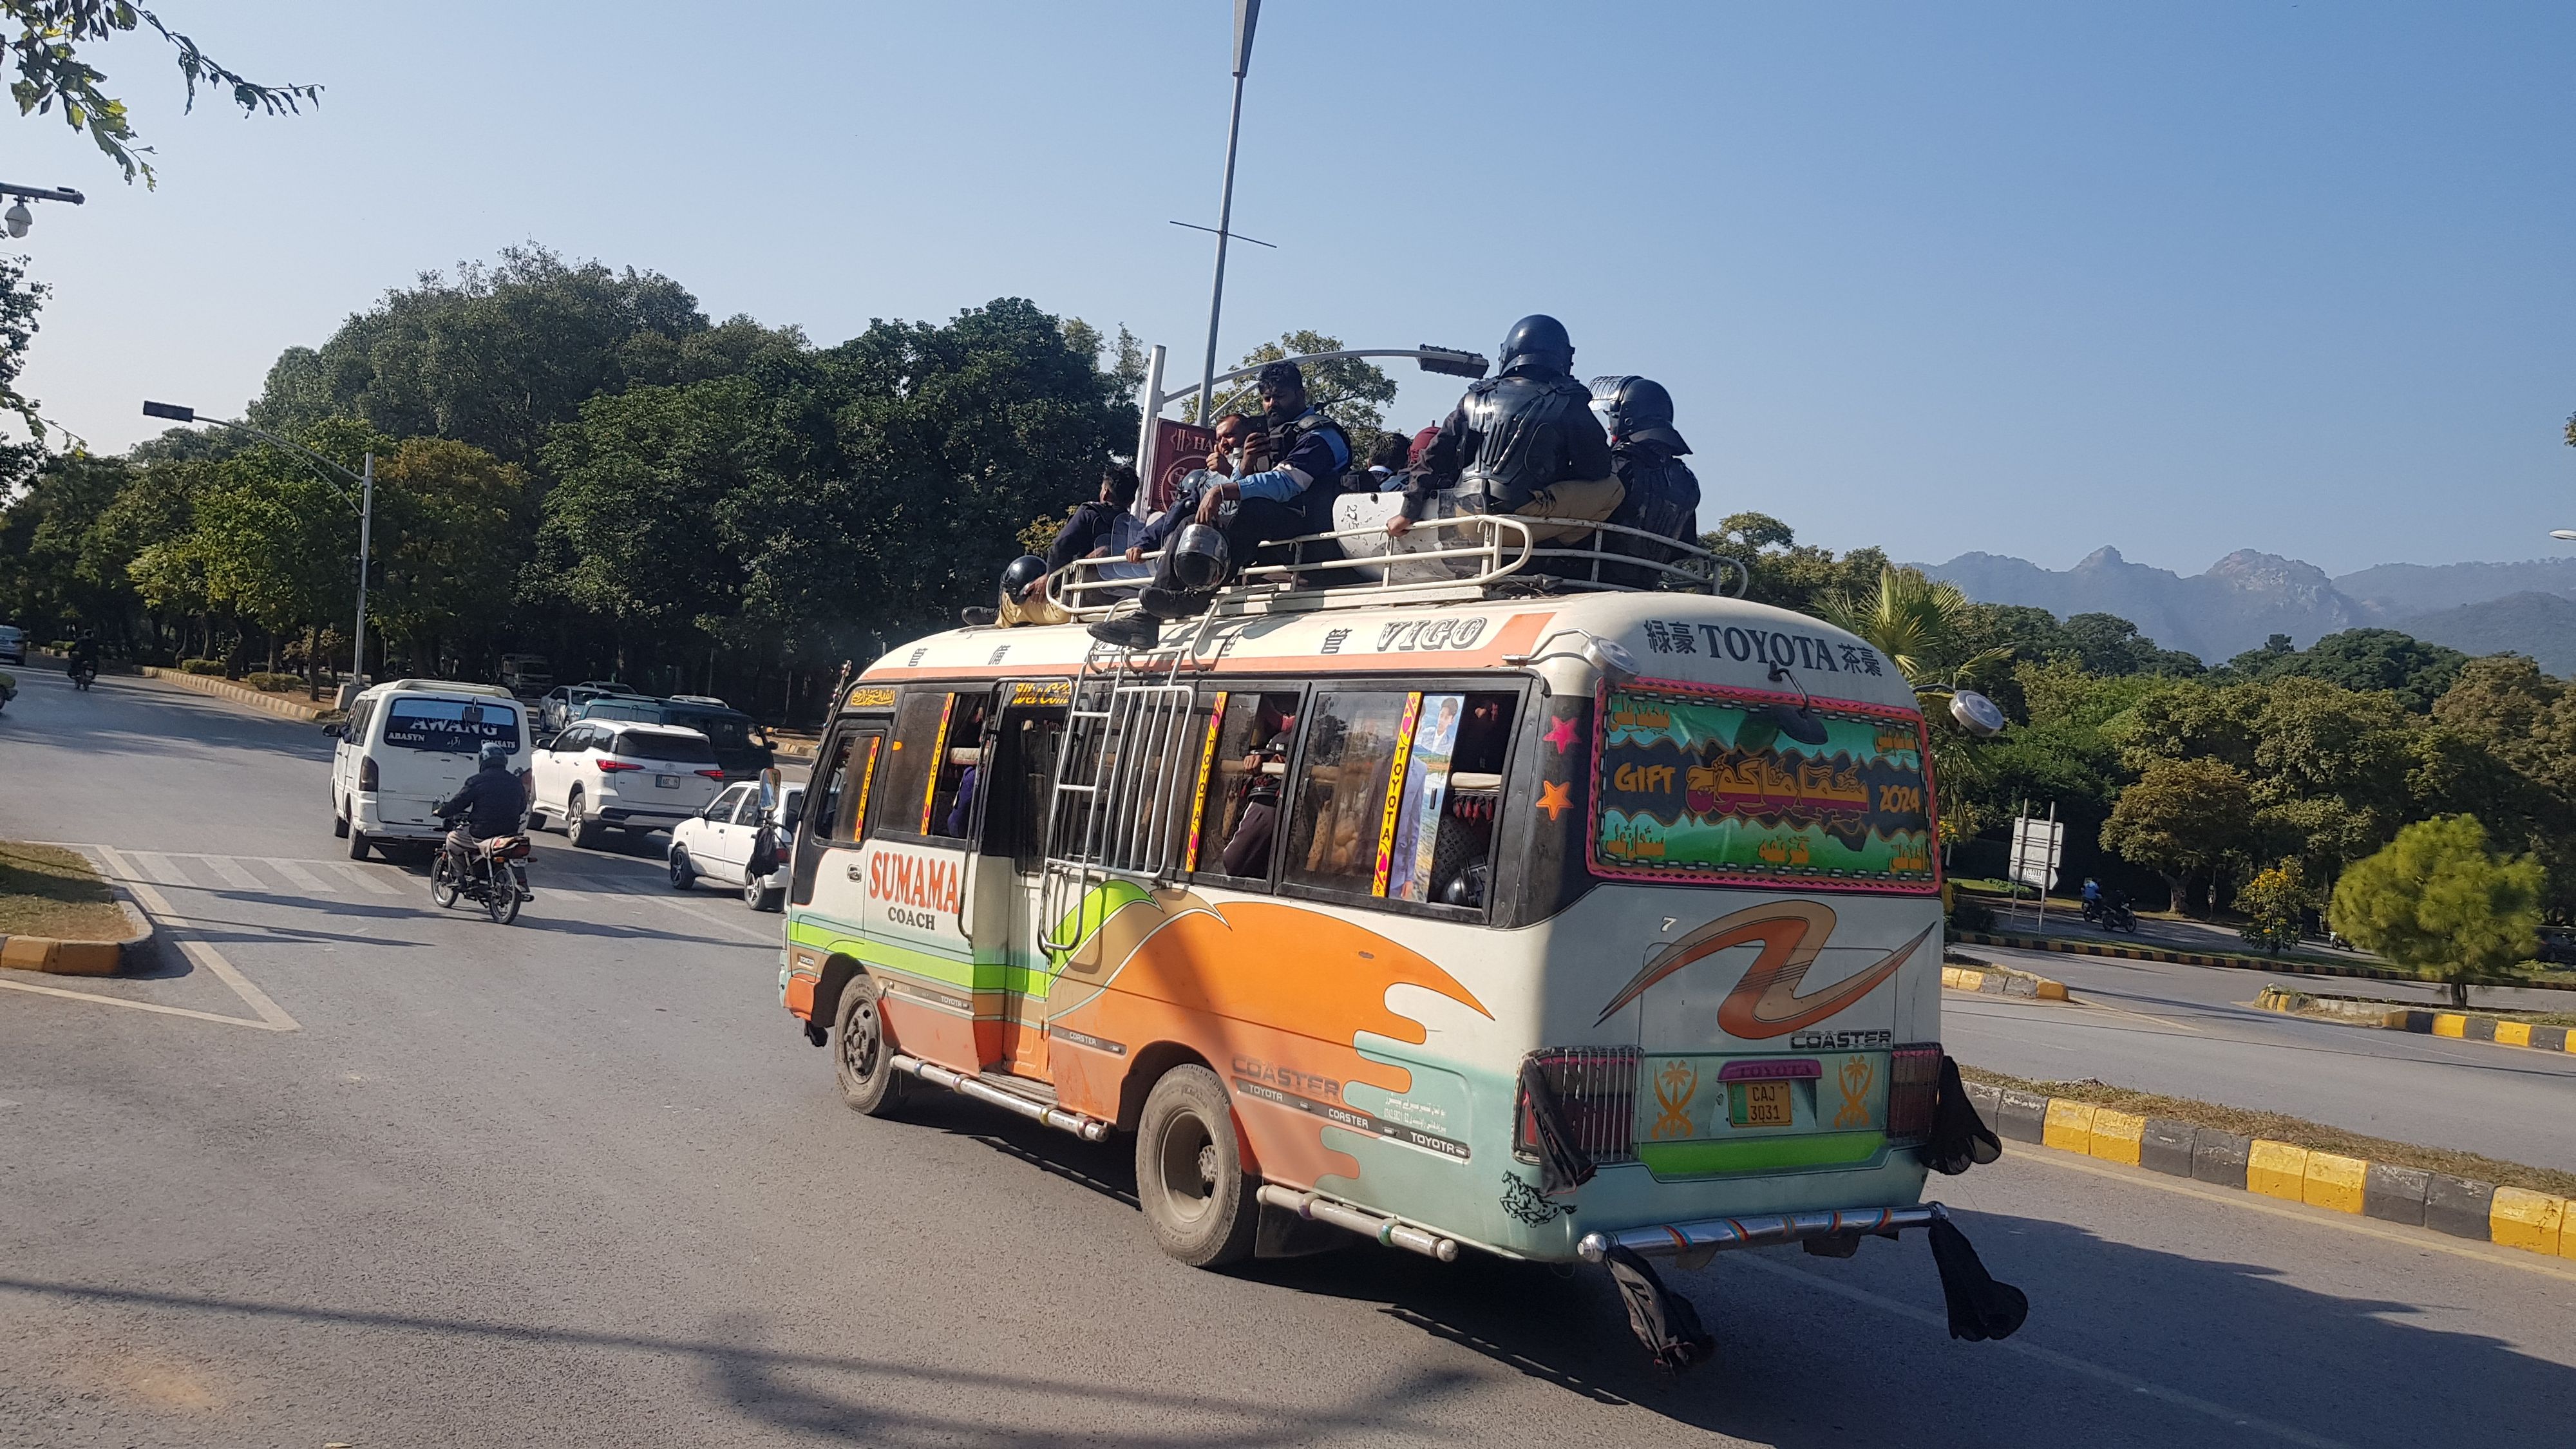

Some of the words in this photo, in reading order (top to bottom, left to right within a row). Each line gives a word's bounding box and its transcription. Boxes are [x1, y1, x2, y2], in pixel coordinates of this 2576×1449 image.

[1377, 617, 1487, 651] VIGO
[1698, 624, 1839, 672] TOYOTA
[388, 732, 425, 742] ABASYN
[410, 717, 498, 735] AWANG
[859, 762, 873, 813] TOYOTA
[1194, 739, 1215, 821] TOYOTA
[1614, 762, 1676, 794] GIFT
[1381, 746, 1406, 841] TOYOTA
[1879, 784, 1920, 813] 2024
[869, 850, 958, 914] SUMAMA
[888, 906, 935, 930] COACH
[1660, 916, 1678, 932] 7
[940, 996, 962, 1007] TOYOTA
[1069, 1032, 1097, 1046] COASTER
[1790, 1030, 1892, 1050] COASTER
[1232, 1057, 1341, 1102] COASTER
[1248, 1084, 1283, 1101] TOYOTA
[1752, 1086, 1776, 1101] CAJ
[1328, 1108, 1369, 1129] COASTER
[1750, 1105, 1780, 1120] 3031
[1410, 1130, 1455, 1154] TOYOTA
